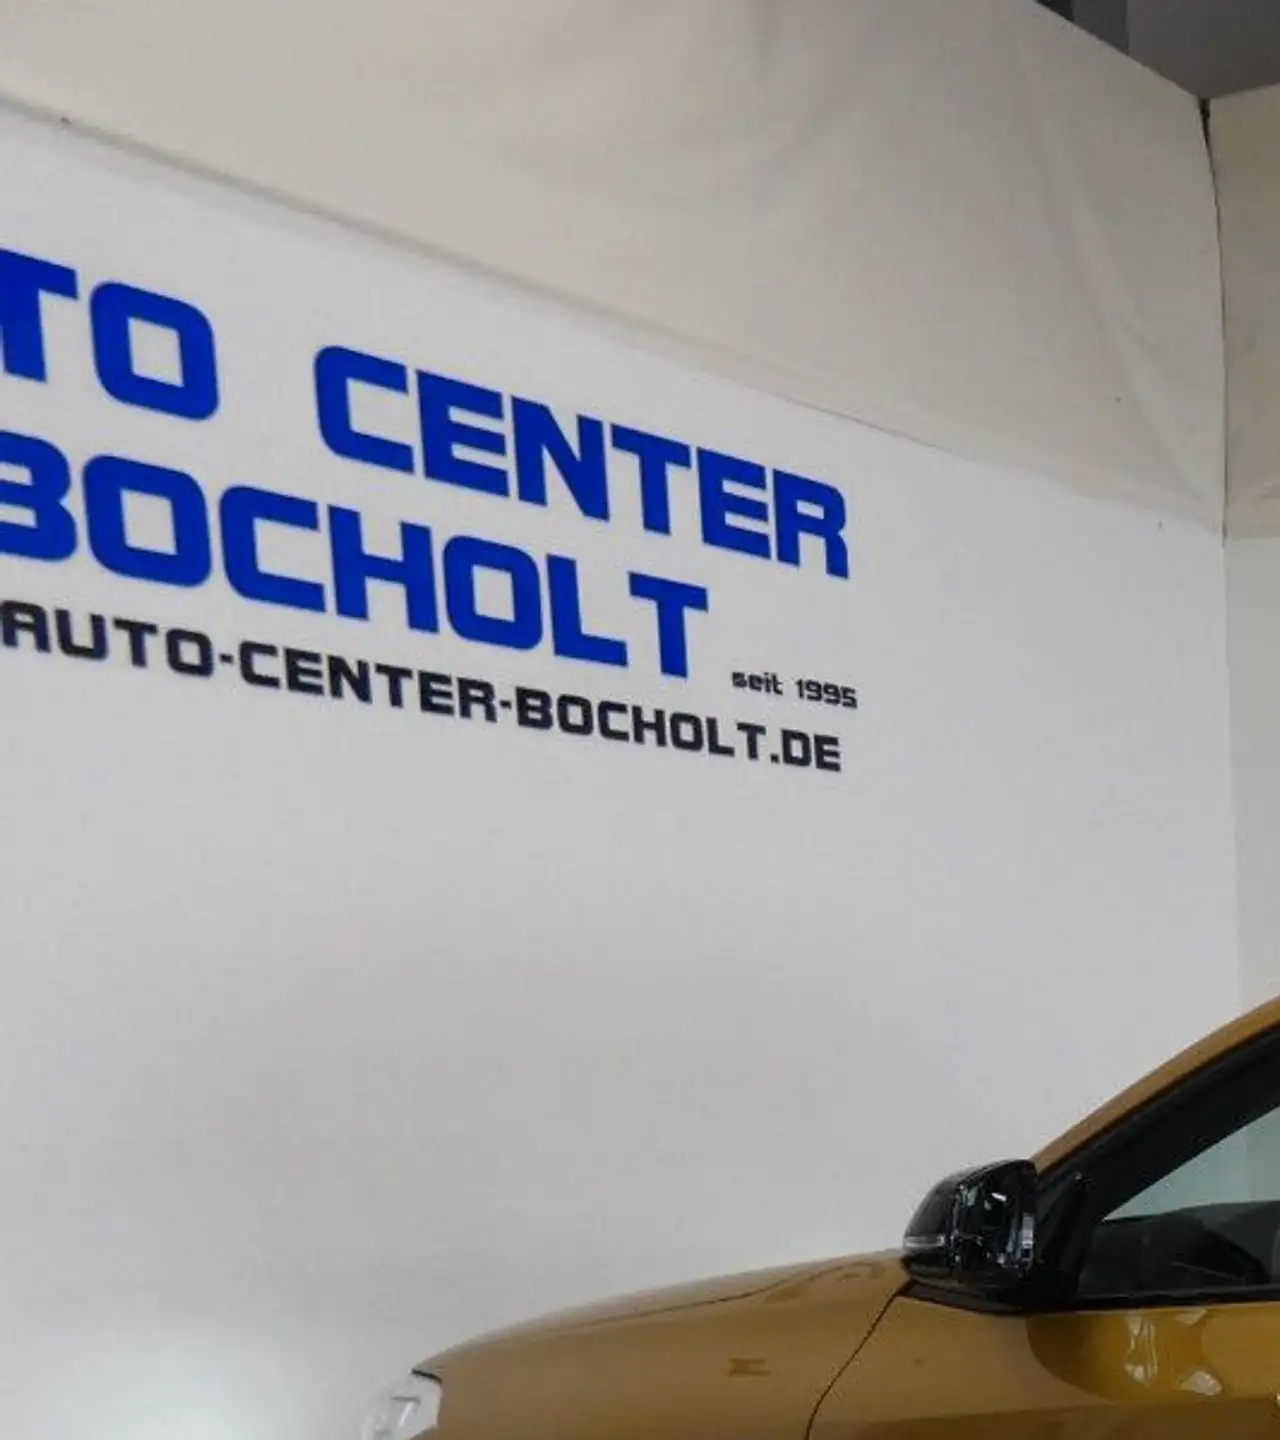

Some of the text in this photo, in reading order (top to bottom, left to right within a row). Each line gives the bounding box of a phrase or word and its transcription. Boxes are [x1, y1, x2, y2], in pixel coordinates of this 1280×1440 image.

[0, 430, 708, 678] BOCHOLT
[314, 346, 849, 579] CENTER
[731, 671, 858, 709] seit 1995
